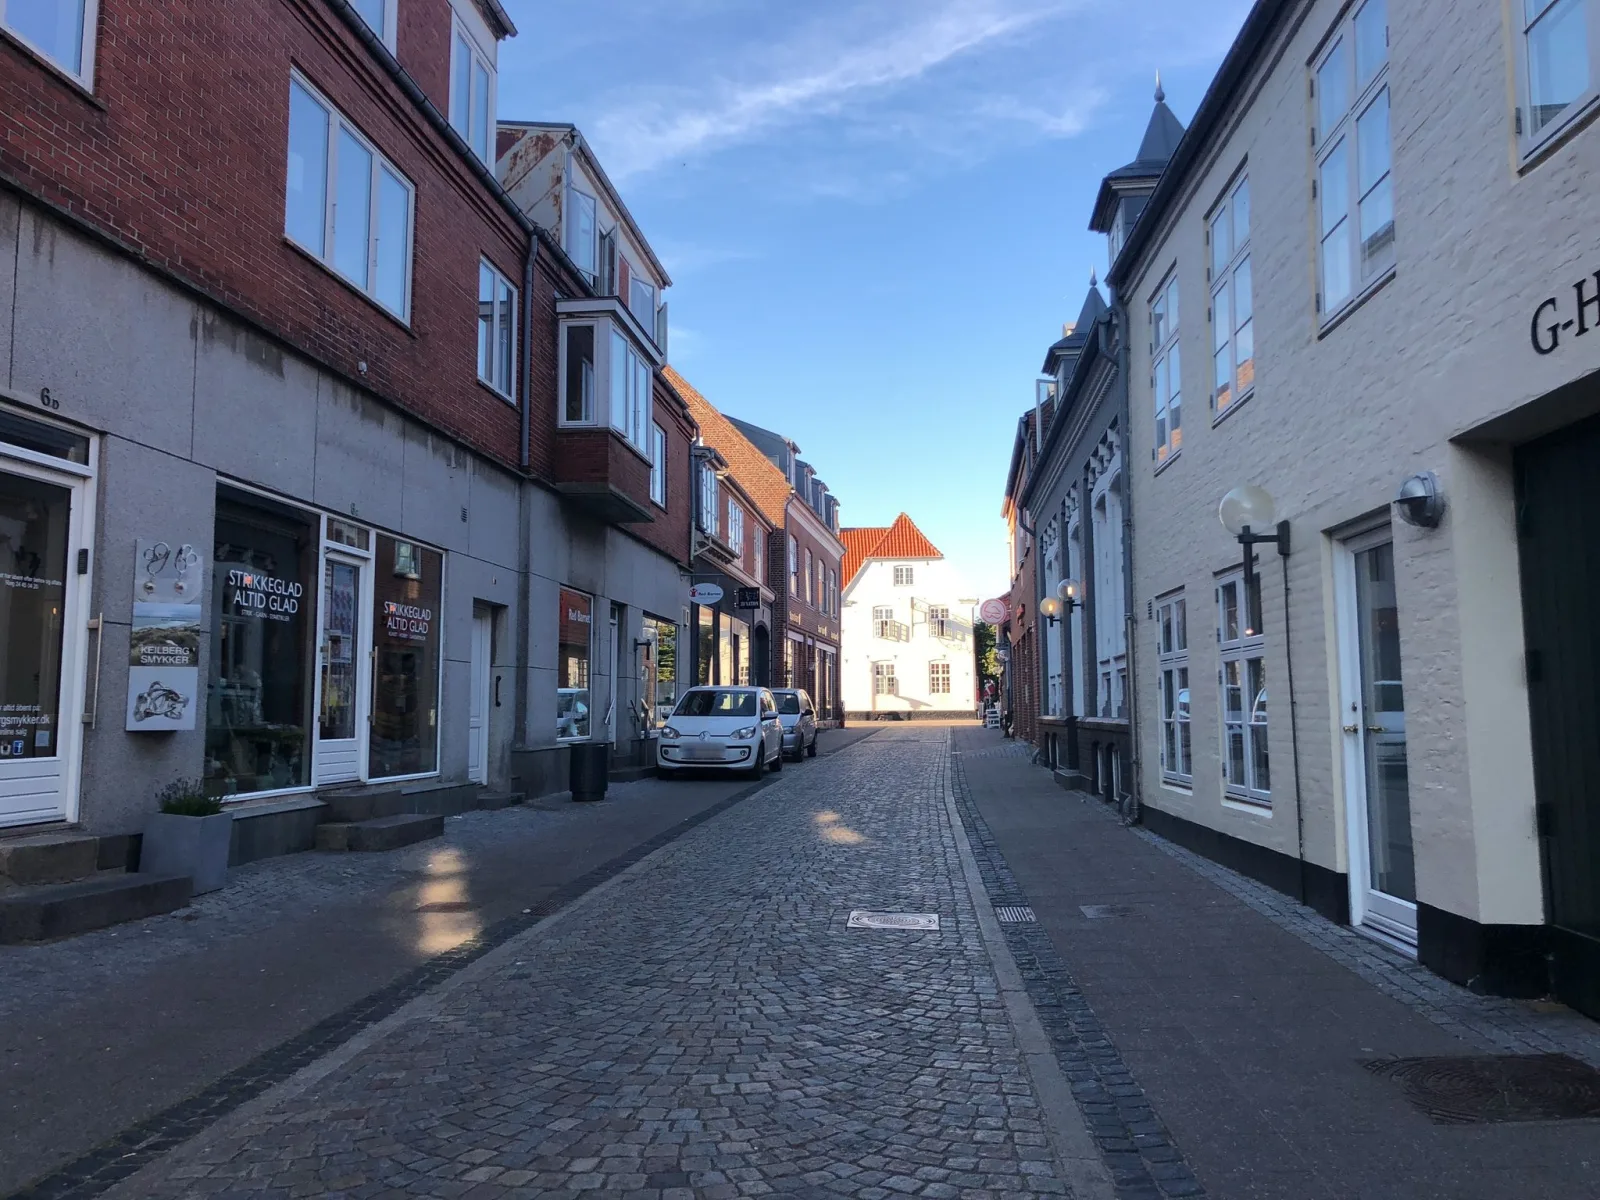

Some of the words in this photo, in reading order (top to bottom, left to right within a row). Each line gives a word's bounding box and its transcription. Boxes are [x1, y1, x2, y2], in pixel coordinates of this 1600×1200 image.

[229, 570, 303, 598] STRIKKEGLAD
[233, 589, 266, 609] ALTID
[268, 595, 298, 614] GLAD
[387, 616, 408, 631] ALTID
[409, 620, 429, 634] GLAD
[140, 646, 190, 655] KEILBERG
[140, 655, 189, 664] SMYKKER
[0, 713, 51, 728] gsmykker.dk
